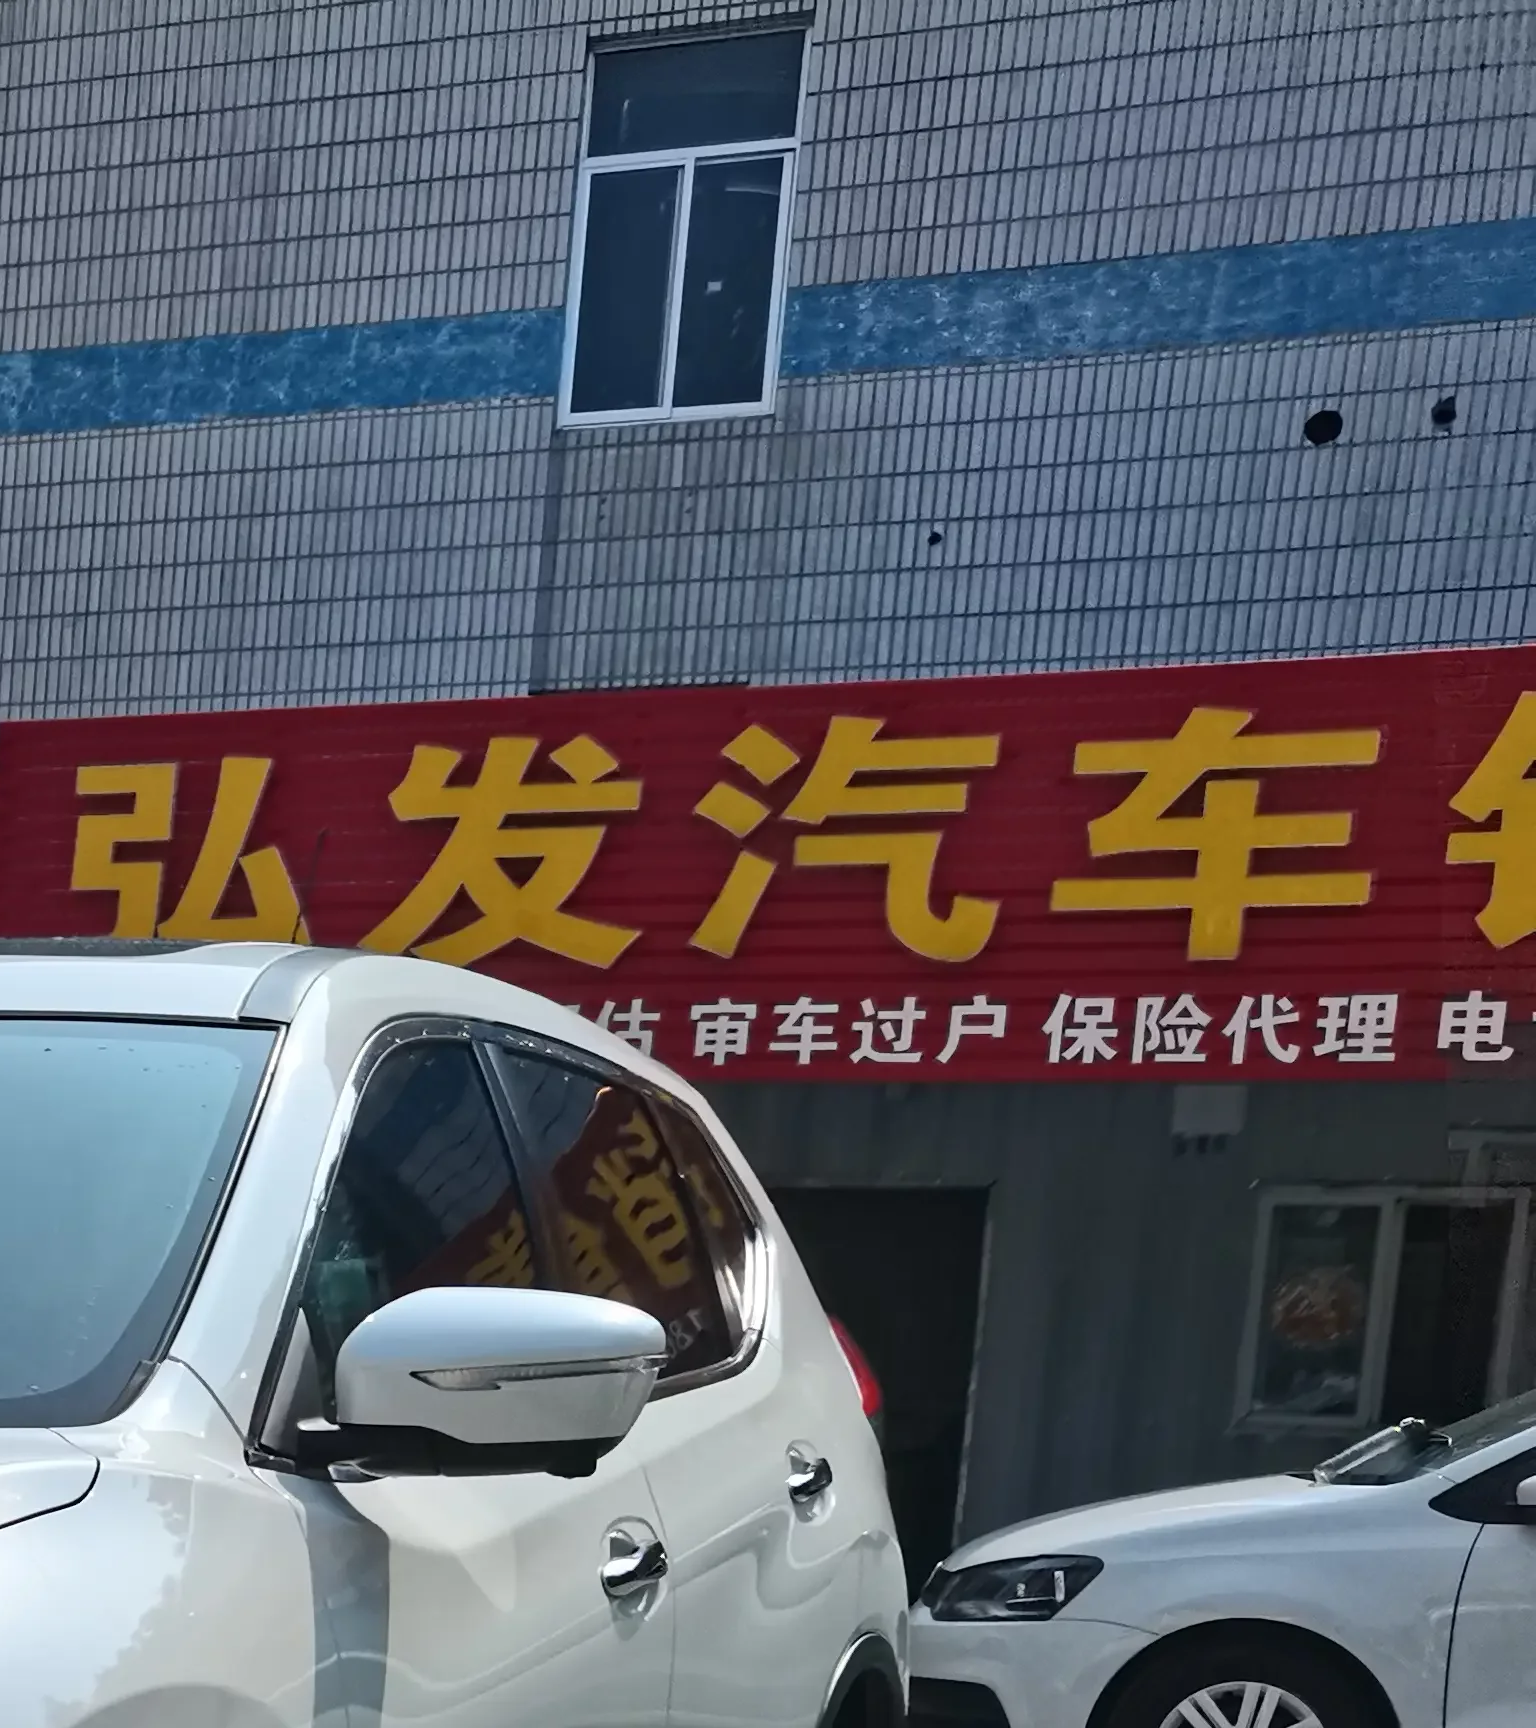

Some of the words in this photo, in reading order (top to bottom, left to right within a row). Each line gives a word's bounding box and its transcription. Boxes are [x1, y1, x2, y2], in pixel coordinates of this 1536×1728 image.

[70, 690, 1536, 969] 弘发汽车
[690, 994, 1008, 1066] 审车过户
[1041, 993, 1400, 1065] 保险代理
[1436, 990, 1536, 1063] 电
